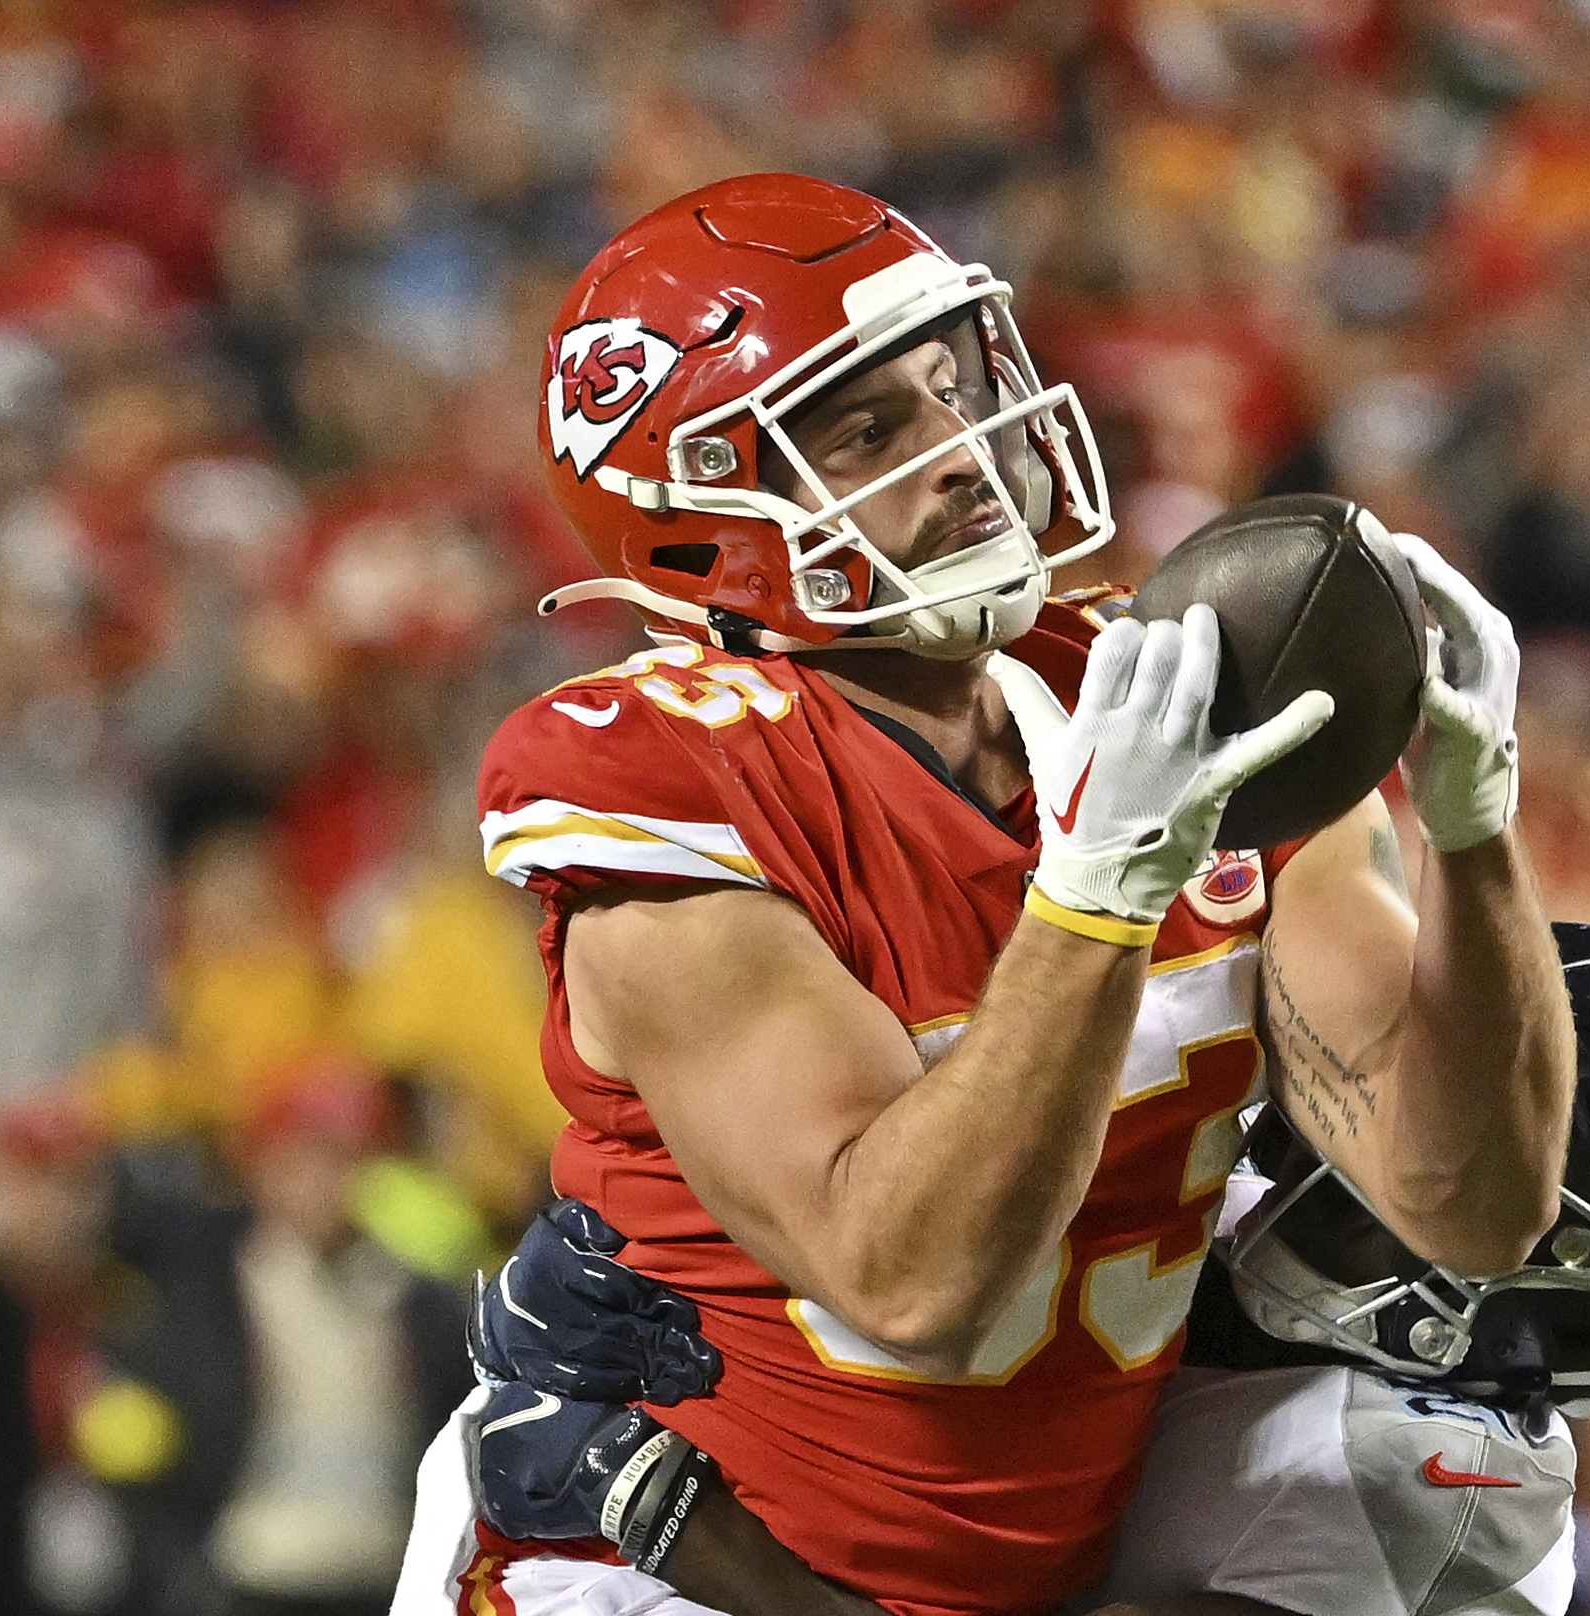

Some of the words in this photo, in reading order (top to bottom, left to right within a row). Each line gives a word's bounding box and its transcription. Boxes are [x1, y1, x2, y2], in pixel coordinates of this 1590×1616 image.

[561, 334, 649, 426] KC
[604, 1494, 624, 1531] HYPE
[623, 1436, 672, 1483] HUMBLE
[673, 1475, 700, 1520] GRIND
